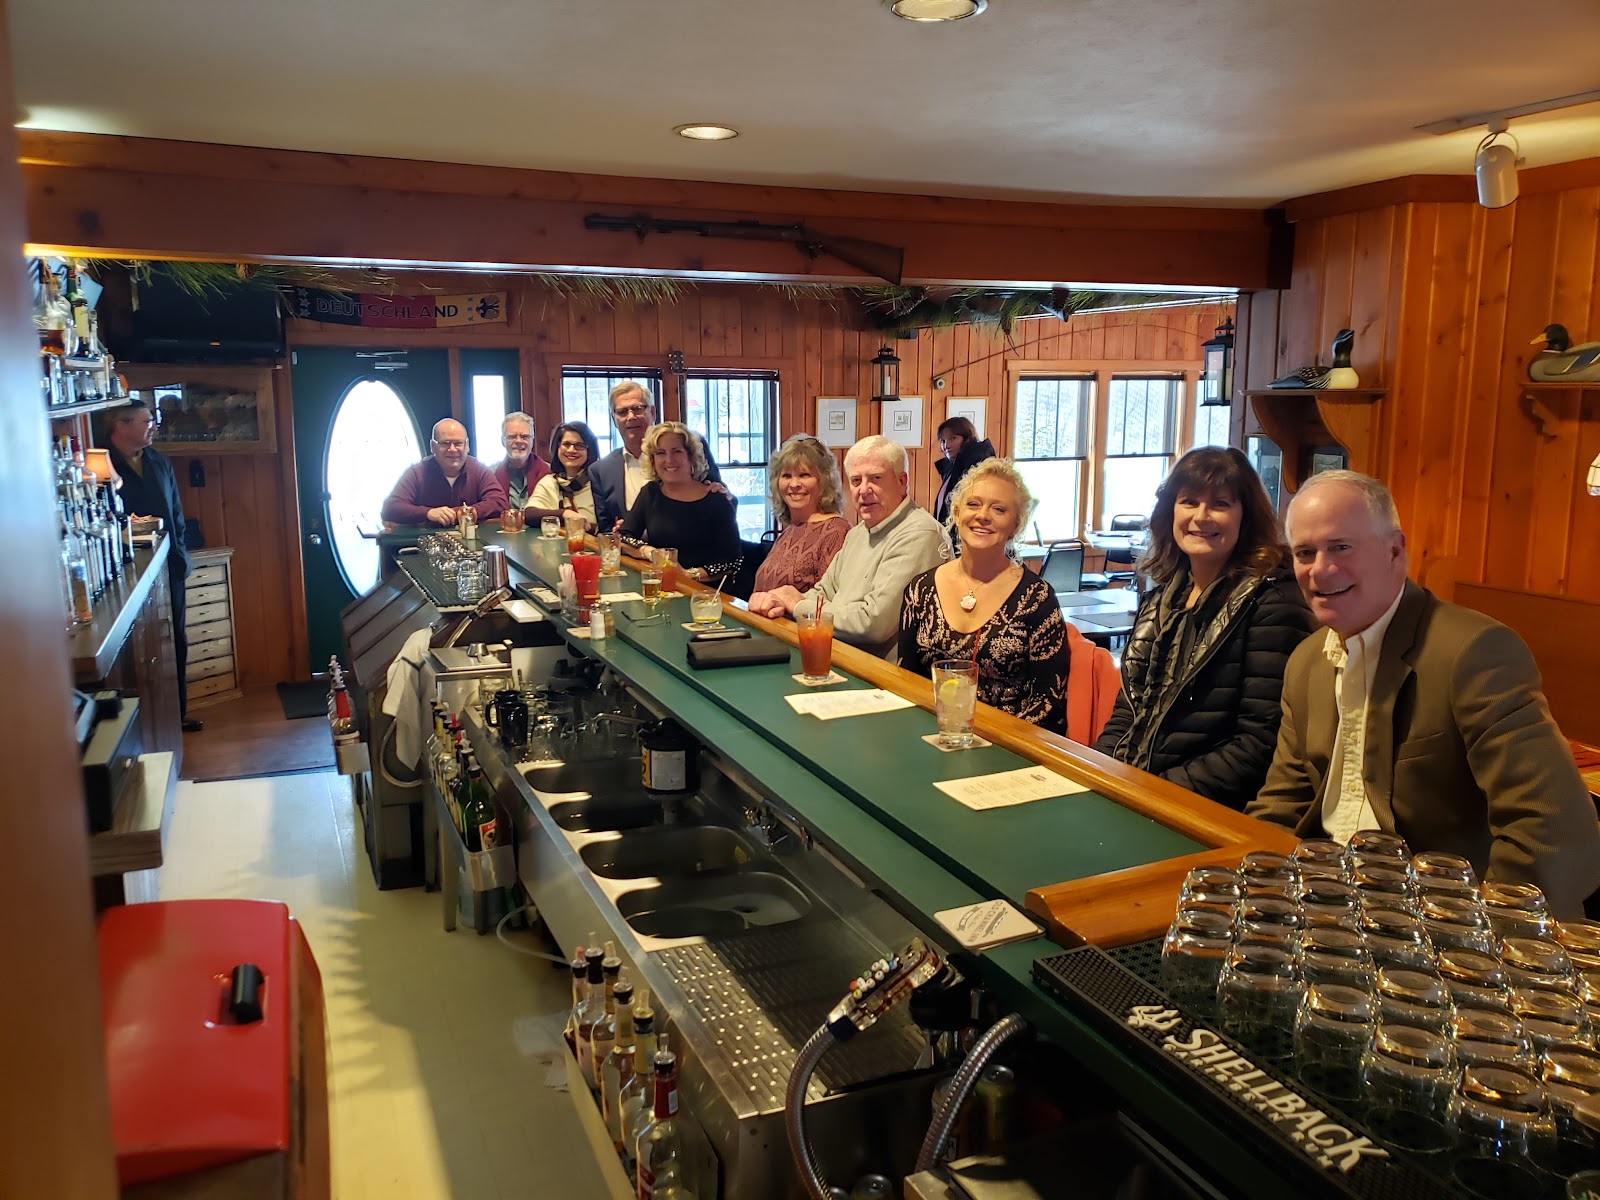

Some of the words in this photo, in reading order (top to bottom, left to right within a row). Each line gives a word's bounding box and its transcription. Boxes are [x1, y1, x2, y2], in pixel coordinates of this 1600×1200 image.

[316, 297, 458, 320] DEUTSCHLAND
[1162, 1043, 1286, 1122] CARIBBEAN
[1291, 1131, 1334, 1168] RUM
[1164, 1028, 1389, 1173] SHELLBACK
